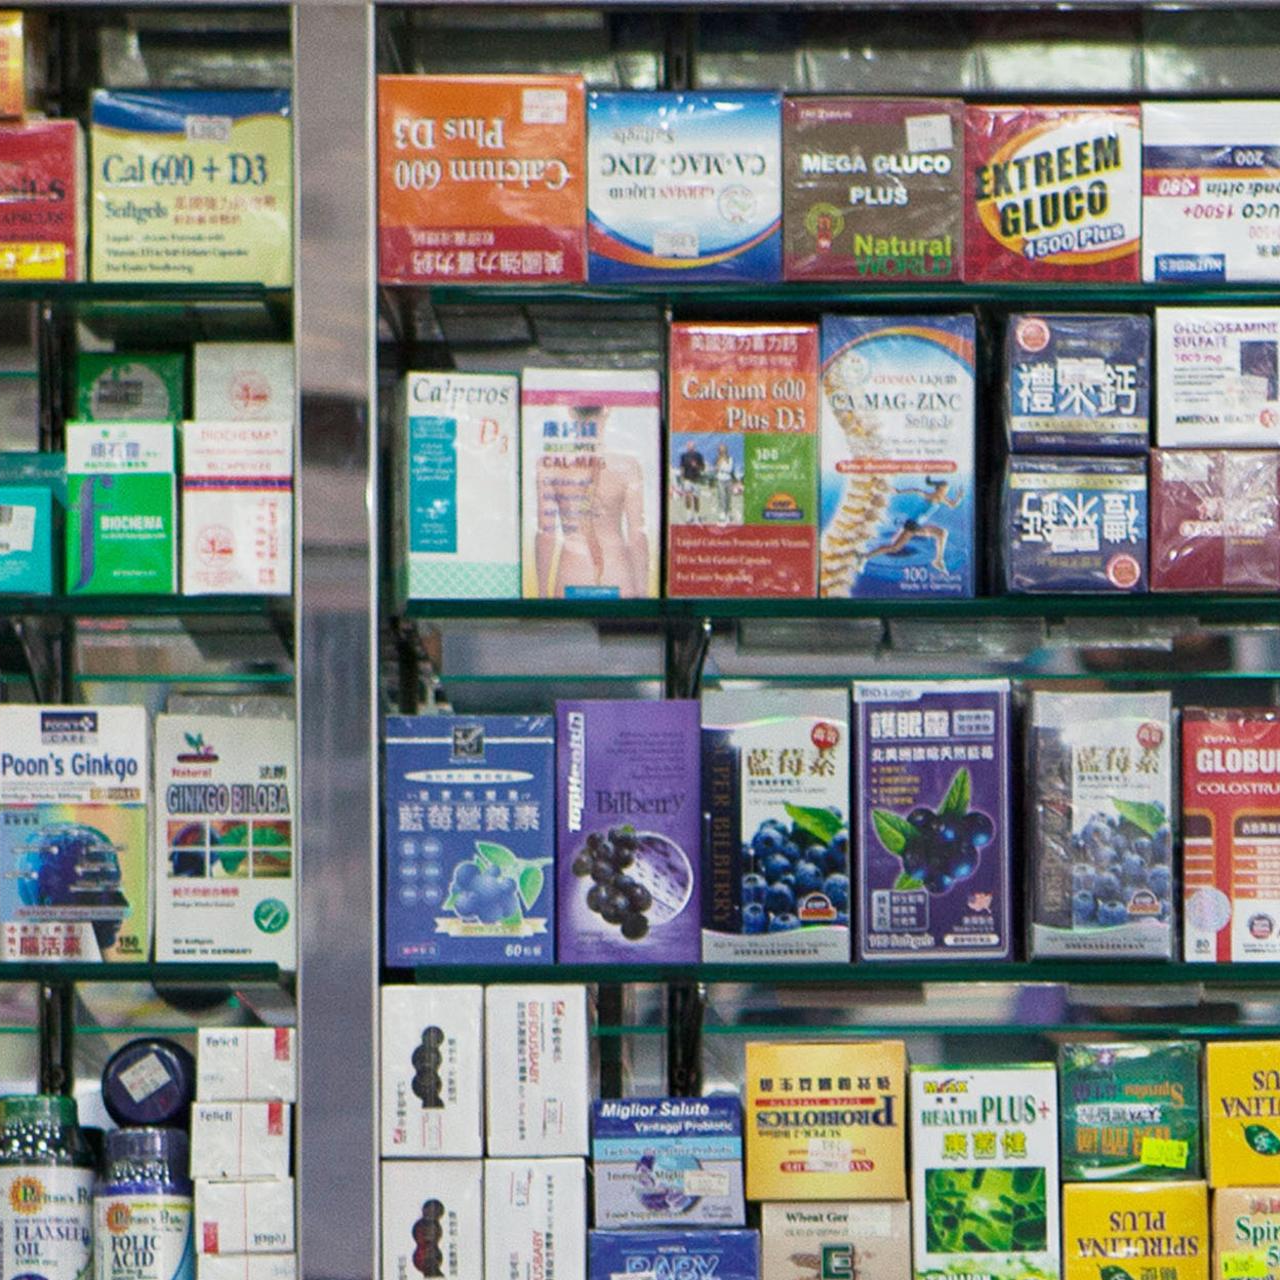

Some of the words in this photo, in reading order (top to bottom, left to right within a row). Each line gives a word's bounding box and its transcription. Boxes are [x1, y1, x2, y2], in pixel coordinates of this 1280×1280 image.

[394, 116, 436, 149] D3
[443, 117, 504, 149] Plus
[102, 155, 145, 186] Cal
[151, 156, 194, 186] 600
[231, 155, 268, 186] D3
[394, 159, 441, 190] 600
[449, 159, 571, 190] Calcium
[802, 155, 867, 175] MEGA
[873, 155, 951, 175] GLUCO
[975, 133, 1122, 202] EXTREEM
[850, 186, 909, 205] PLUS
[998, 179, 1108, 239] GLUCO
[854, 234, 952, 256] Natural
[1023, 229, 1076, 259] 1500
[1077, 223, 1125, 248] Plus
[1, 753, 66, 778] Poon's
[71, 753, 139, 781] Ginkgo
[166, 784, 228, 815] GINKGO
[398, 805, 541, 833] 藍莓營養素
[602, 1102, 656, 1121] Miglior
[660, 1102, 709, 1117] Salute
[757, 1096, 896, 1128] PROBIOTICS
[1110, 1210, 1166, 1232] PLUS
